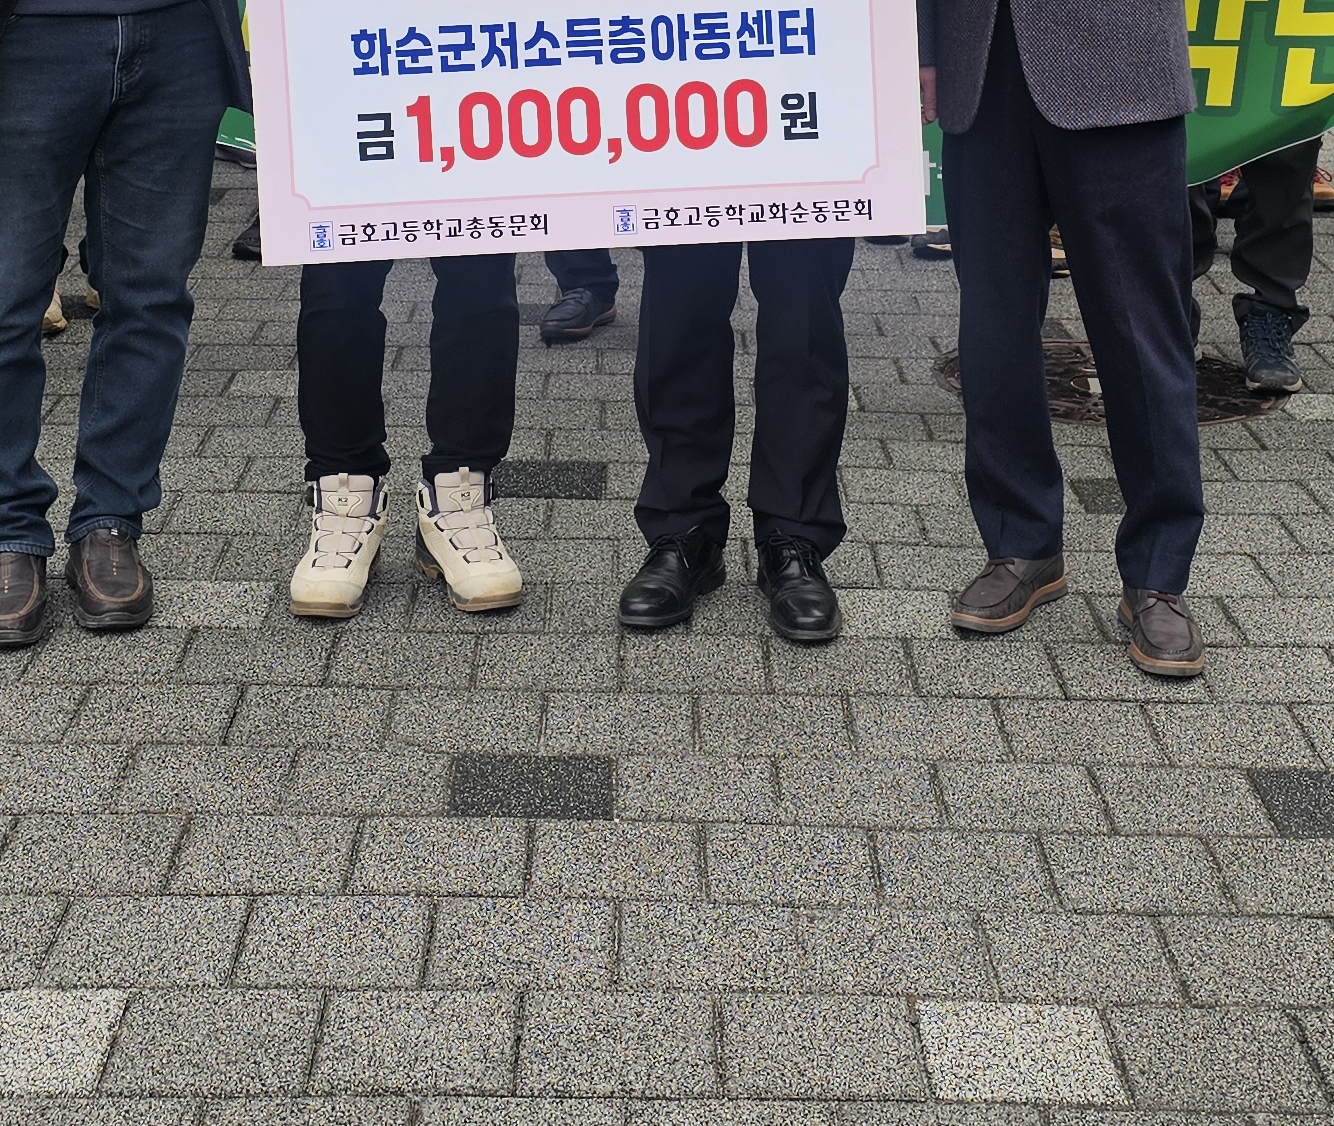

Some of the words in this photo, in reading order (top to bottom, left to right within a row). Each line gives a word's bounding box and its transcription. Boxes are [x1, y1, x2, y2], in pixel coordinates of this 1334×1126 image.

[351, 8, 815, 75] 화순군저소득층아동센터
[357, 113, 394, 161] 금
[406, 79, 768, 172] 1,000,000
[781, 92, 818, 140] 원
[339, 214, 547, 245] 금호고등학교총동문회
[643, 199, 872, 229] 금호고등학교화순동문회
